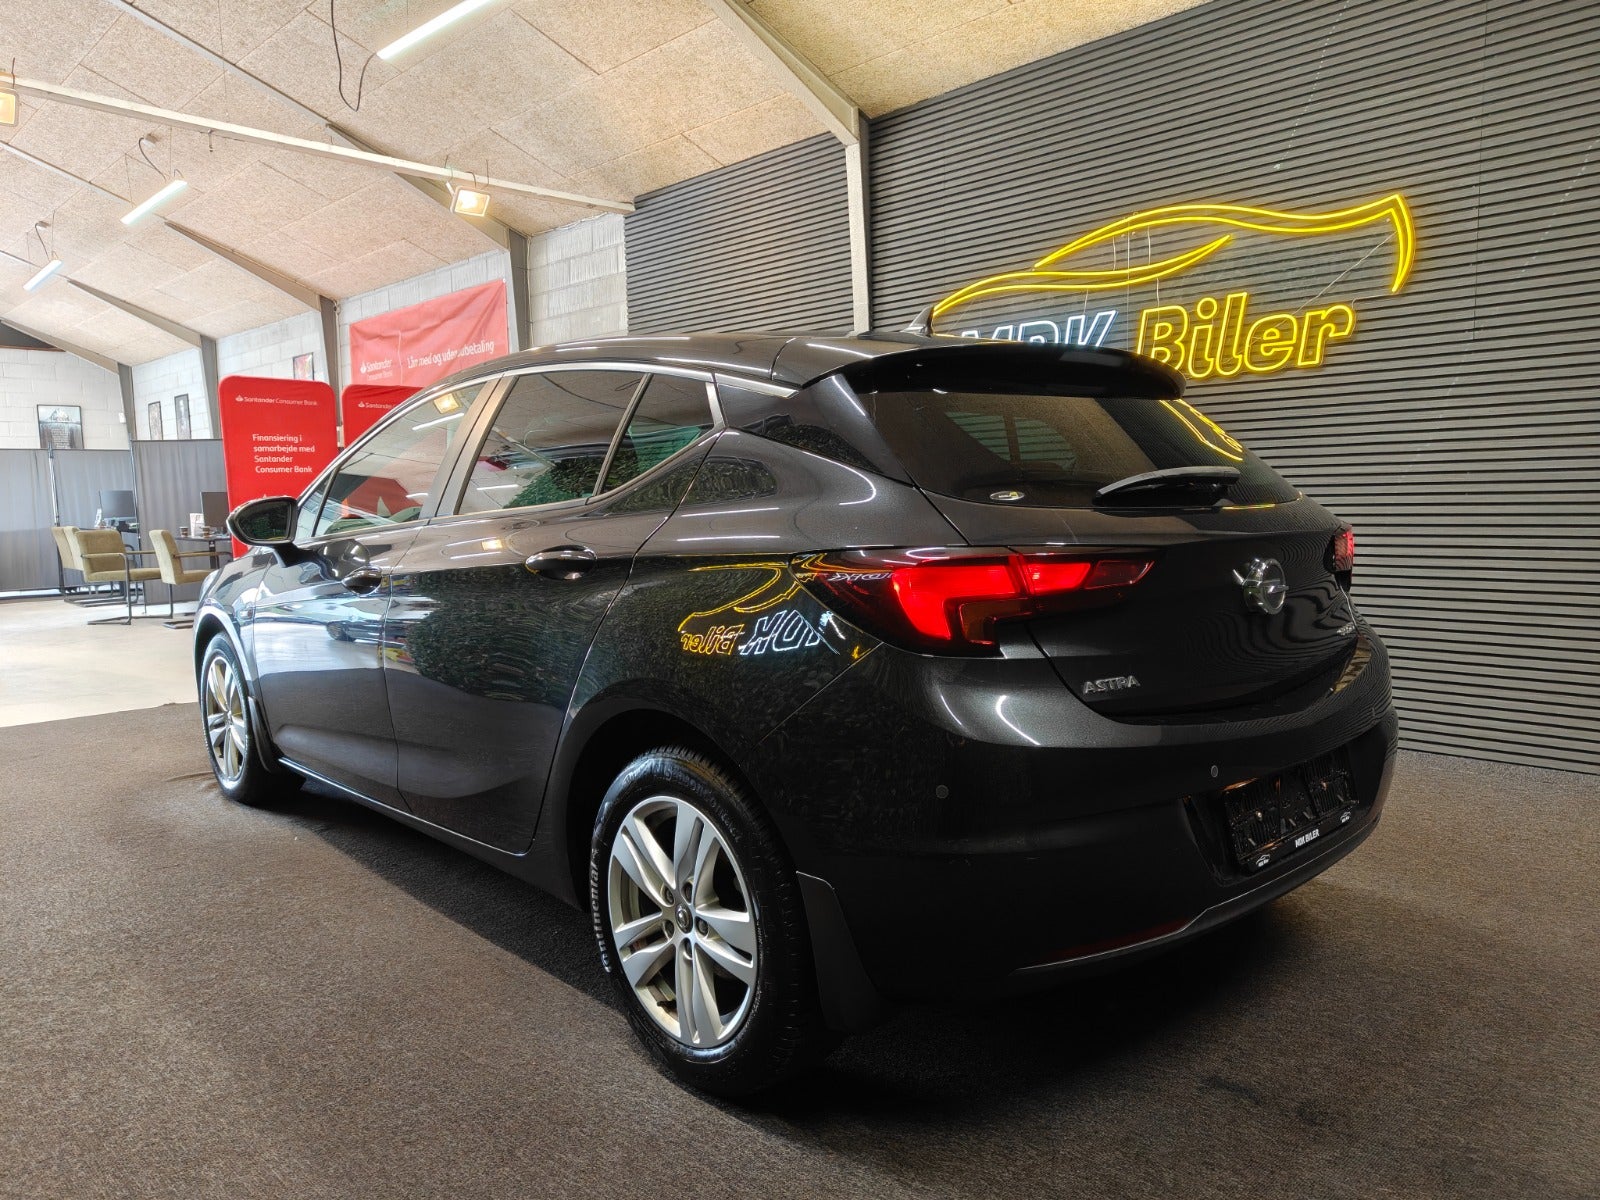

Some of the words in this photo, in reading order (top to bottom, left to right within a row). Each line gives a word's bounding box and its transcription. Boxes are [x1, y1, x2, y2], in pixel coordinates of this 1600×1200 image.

[1136, 292, 1354, 378] Biler
[366, 358, 392, 372] Santander
[432, 353, 442, 367] og
[244, 396, 275, 404] Santander
[275, 397, 303, 405] Consumer
[252, 433, 299, 444] Finansiering
[253, 444, 298, 453] samarbejde
[299, 444, 315, 453] med
[254, 454, 294, 463] Santander
[255, 465, 293, 474] Consumer
[293, 465, 313, 473] Bank
[1082, 675, 1141, 694] ASTRA
[590, 860, 611, 973] Continental
